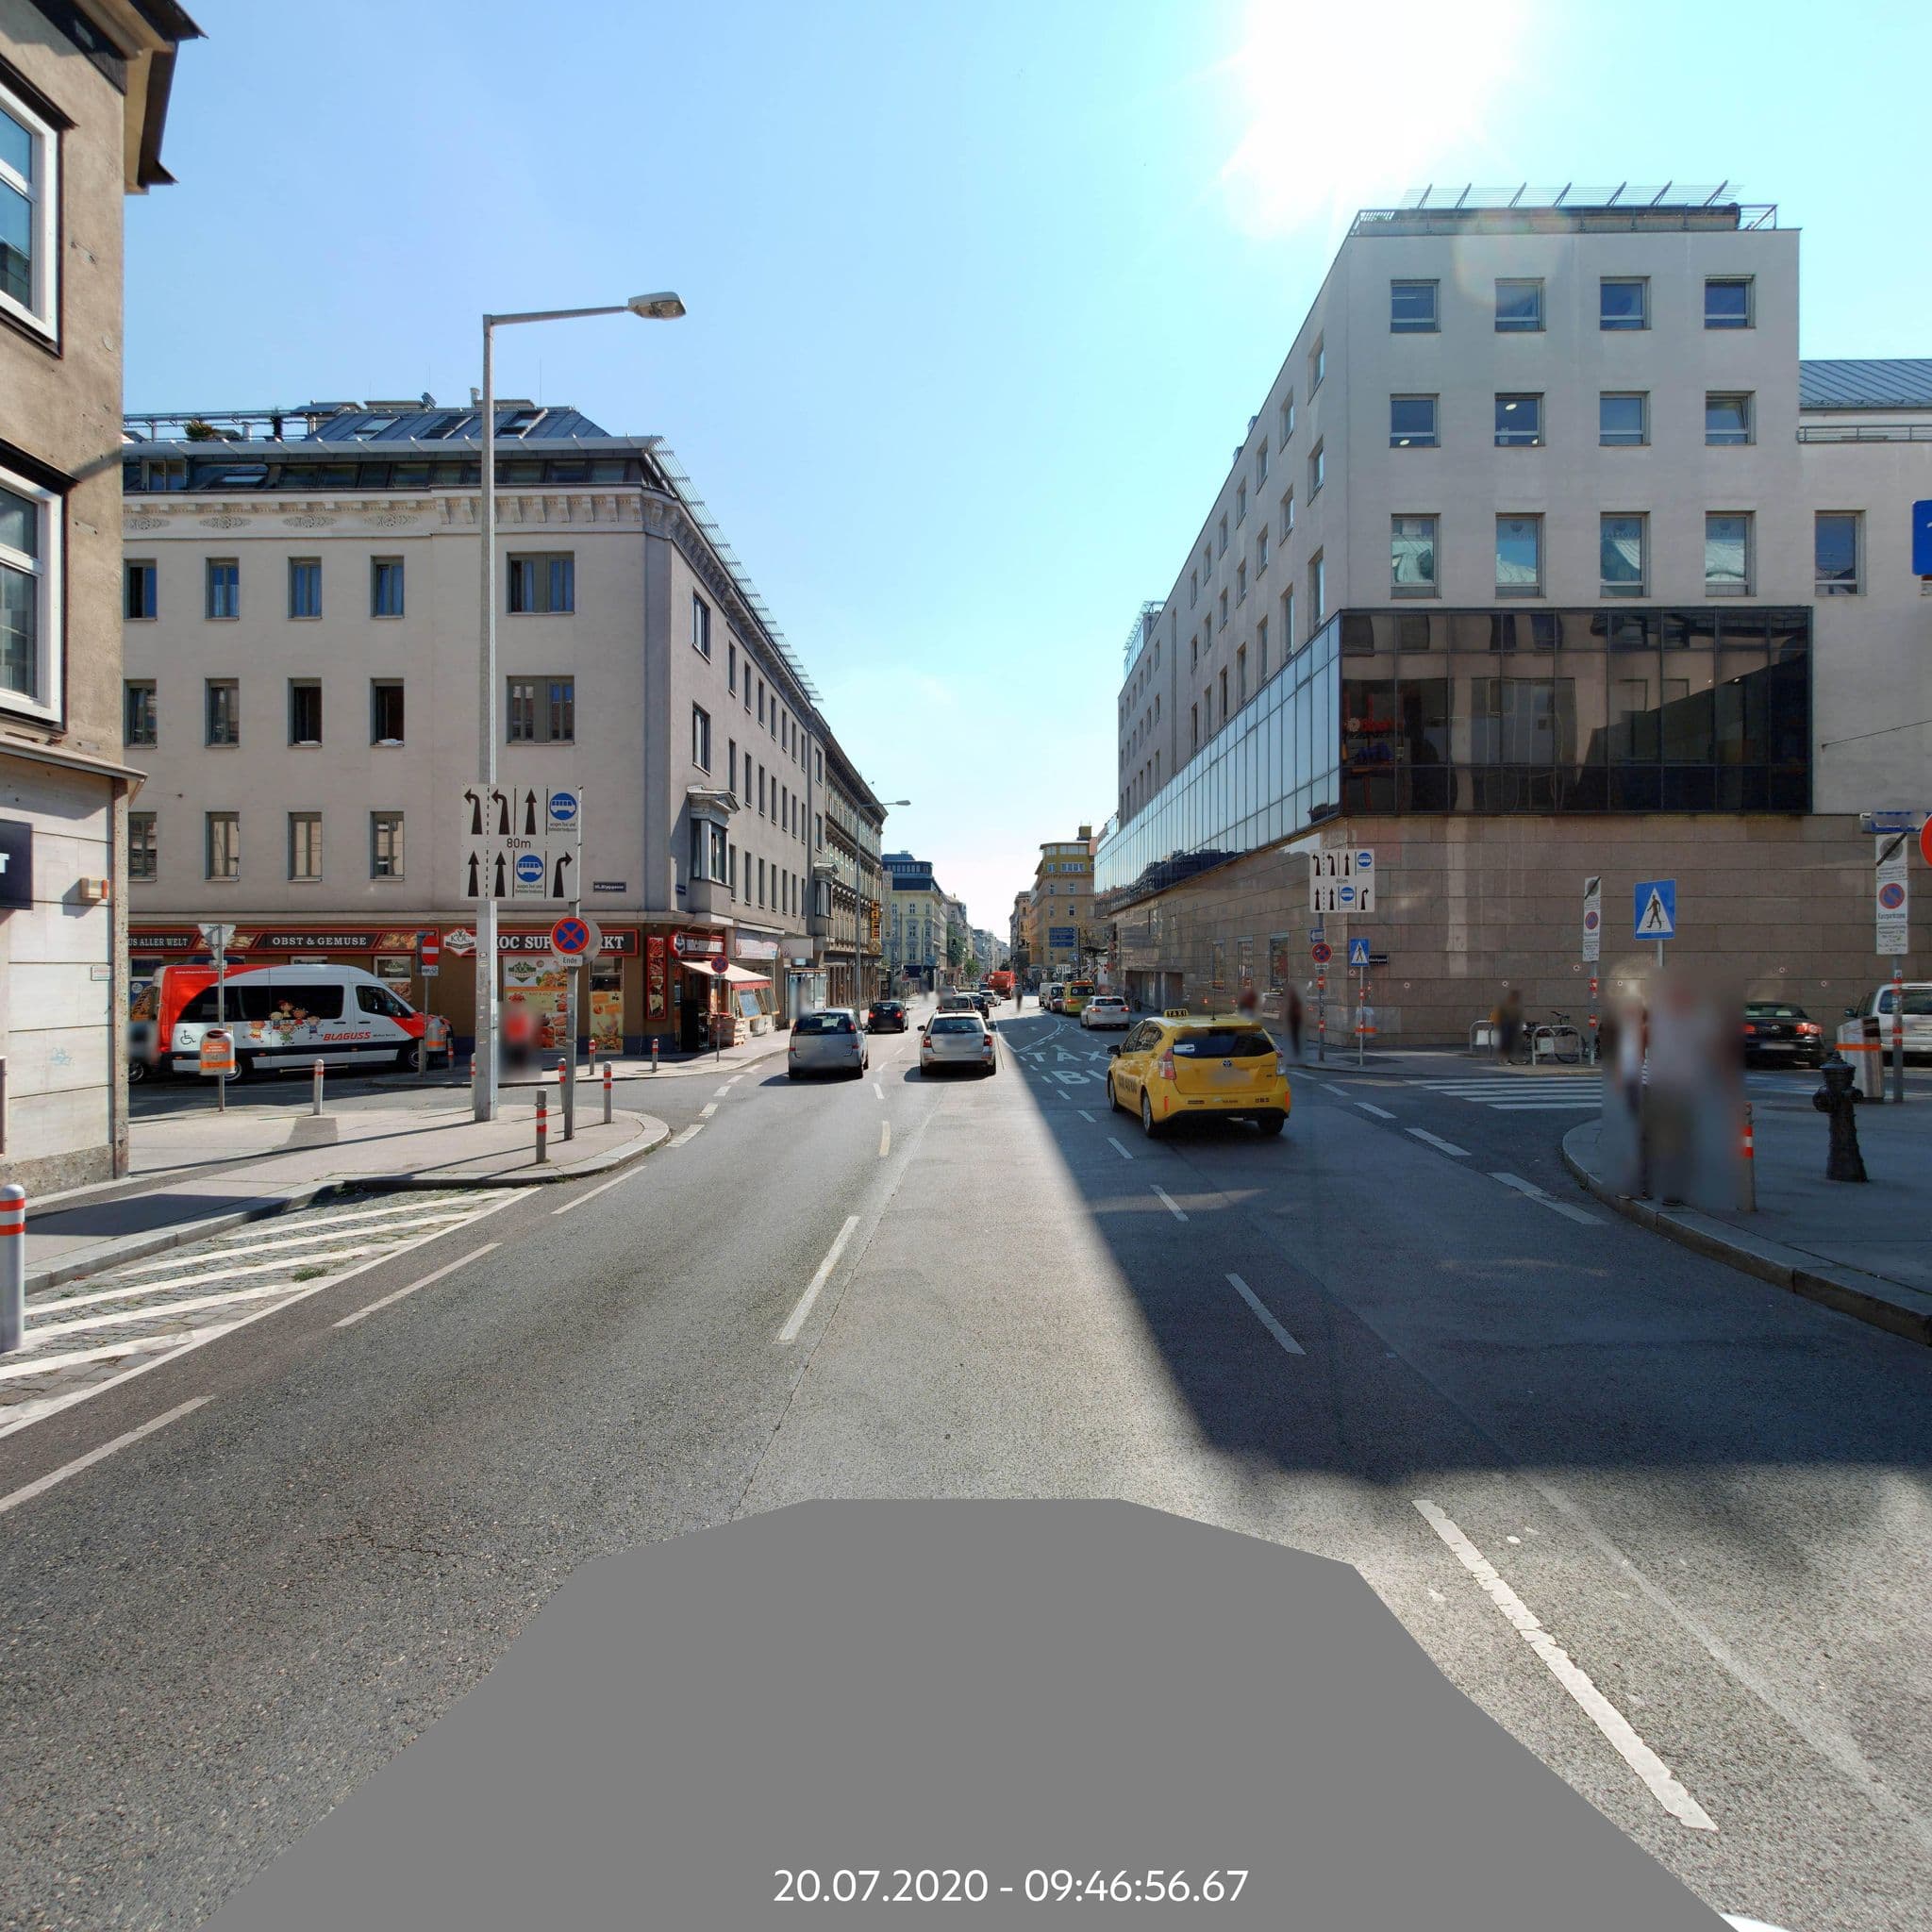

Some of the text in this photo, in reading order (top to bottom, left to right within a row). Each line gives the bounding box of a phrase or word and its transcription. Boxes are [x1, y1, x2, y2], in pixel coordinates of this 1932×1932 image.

[507, 838, 531, 848] 80m
[128, 938, 189, 946] US ALLER WELT
[272, 937, 304, 945] OBST
[307, 937, 315, 945] &
[323, 1031, 371, 1041] BLAGUSS
[1026, 1051, 1111, 1062] TAX
